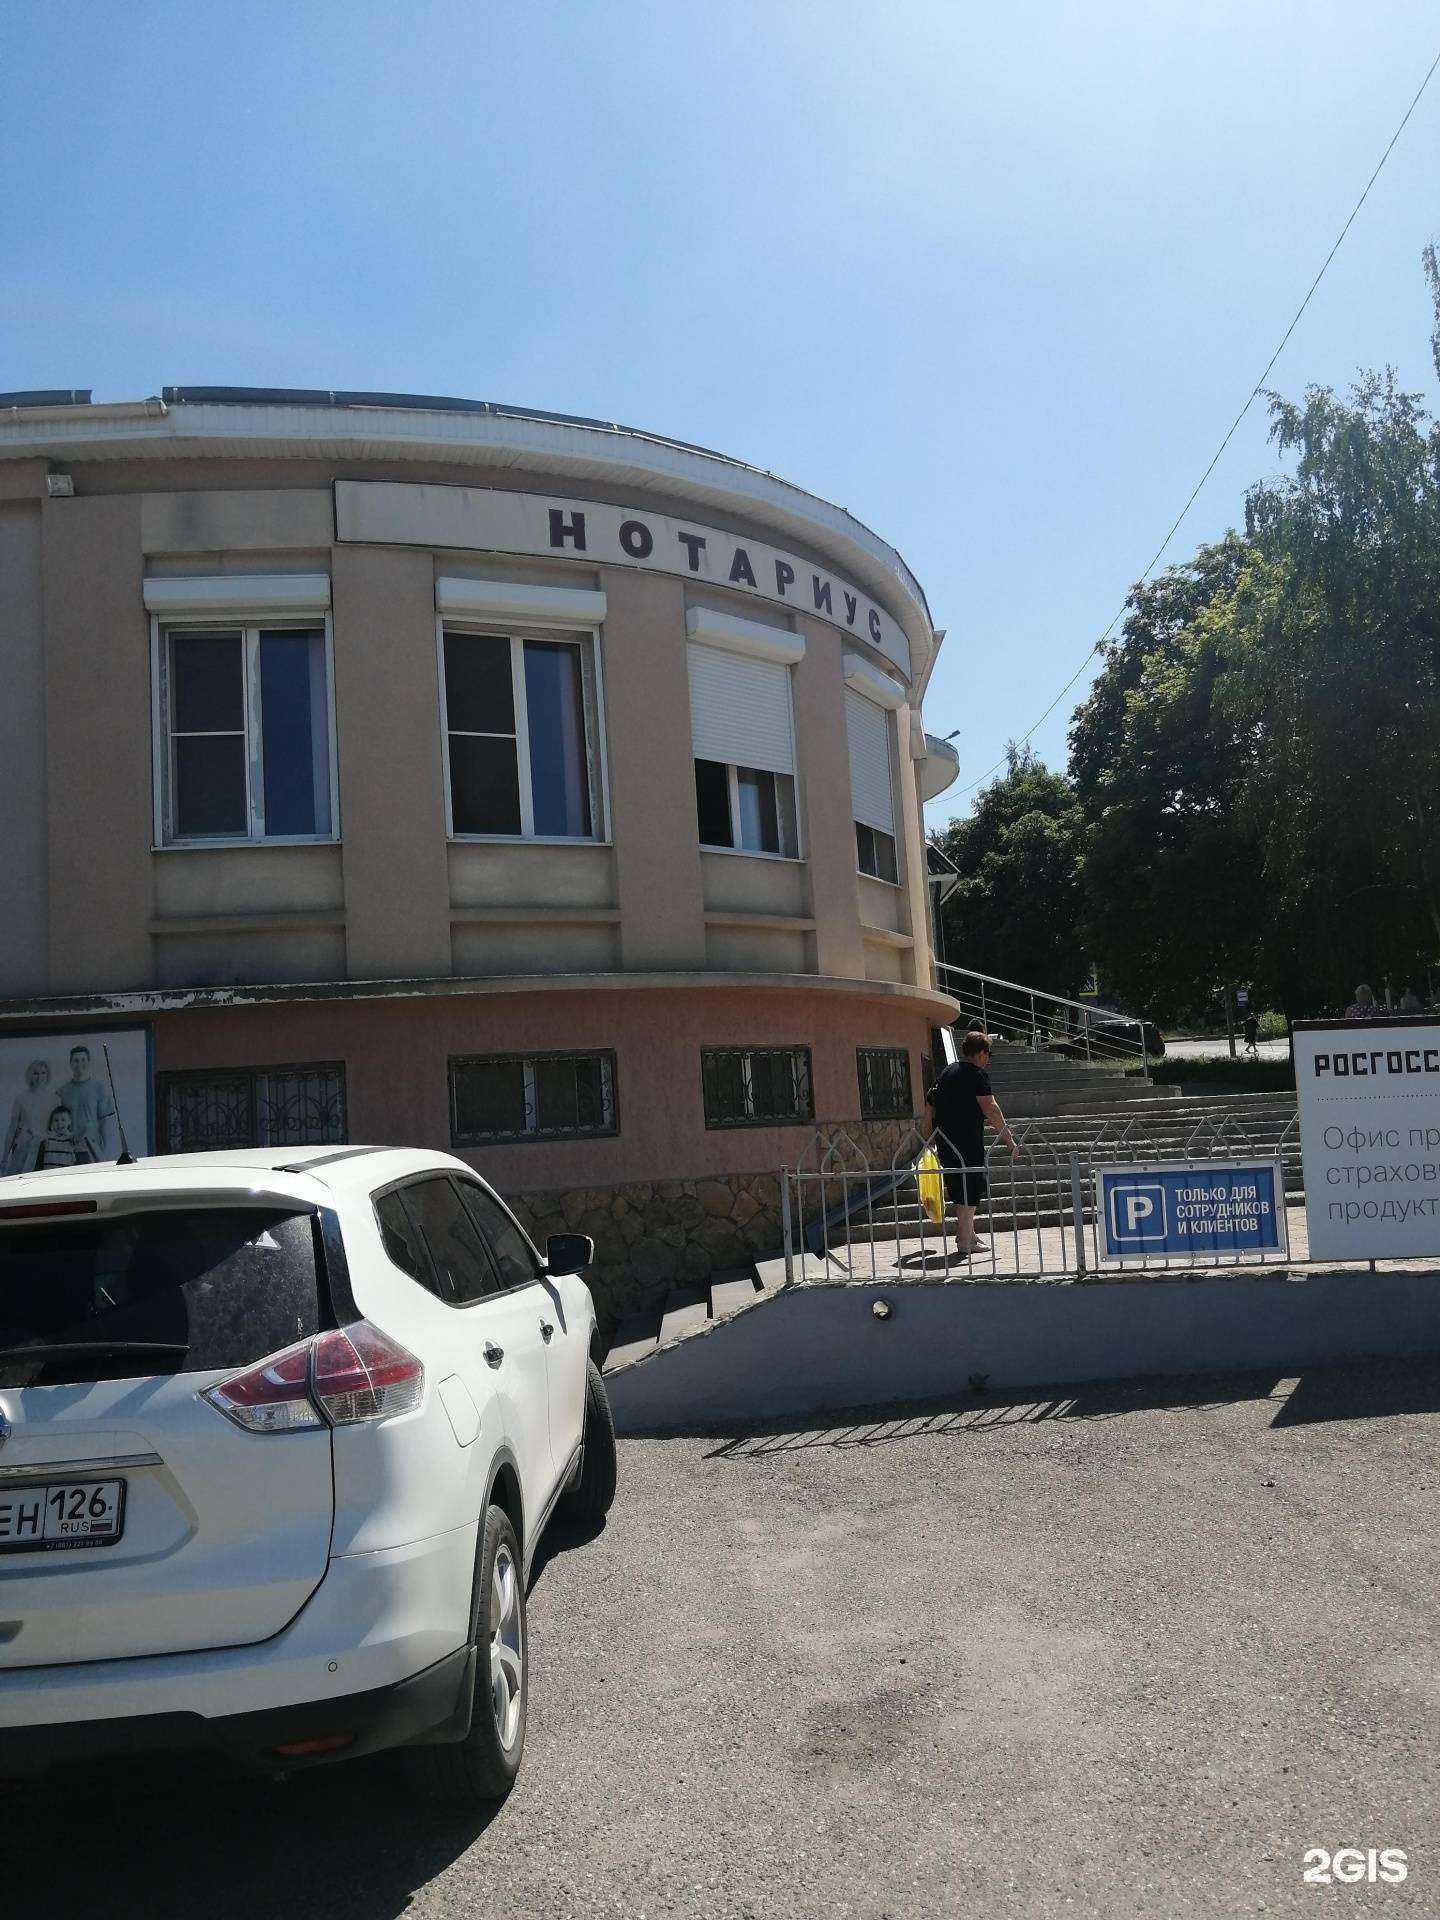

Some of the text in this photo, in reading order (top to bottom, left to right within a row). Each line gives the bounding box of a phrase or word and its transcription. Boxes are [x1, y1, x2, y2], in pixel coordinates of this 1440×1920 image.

[548, 508, 882, 643] НОТАРИУС
[1323, 1125, 1400, 1153] Офис
[1326, 1163, 1440, 1188] страхов
[1175, 1185, 1257, 1202] ТОЛЬКО ДЛЯ
[1126, 1196, 1153, 1230] P
[1176, 1201, 1270, 1219] СОТРУДНИКОВ
[1328, 1198, 1440, 1224] продукт
[1178, 1218, 1258, 1234] И КЛИЕНТОВ
[50, 1487, 107, 1520] 126
[61, 1521, 90, 1534] RUS
